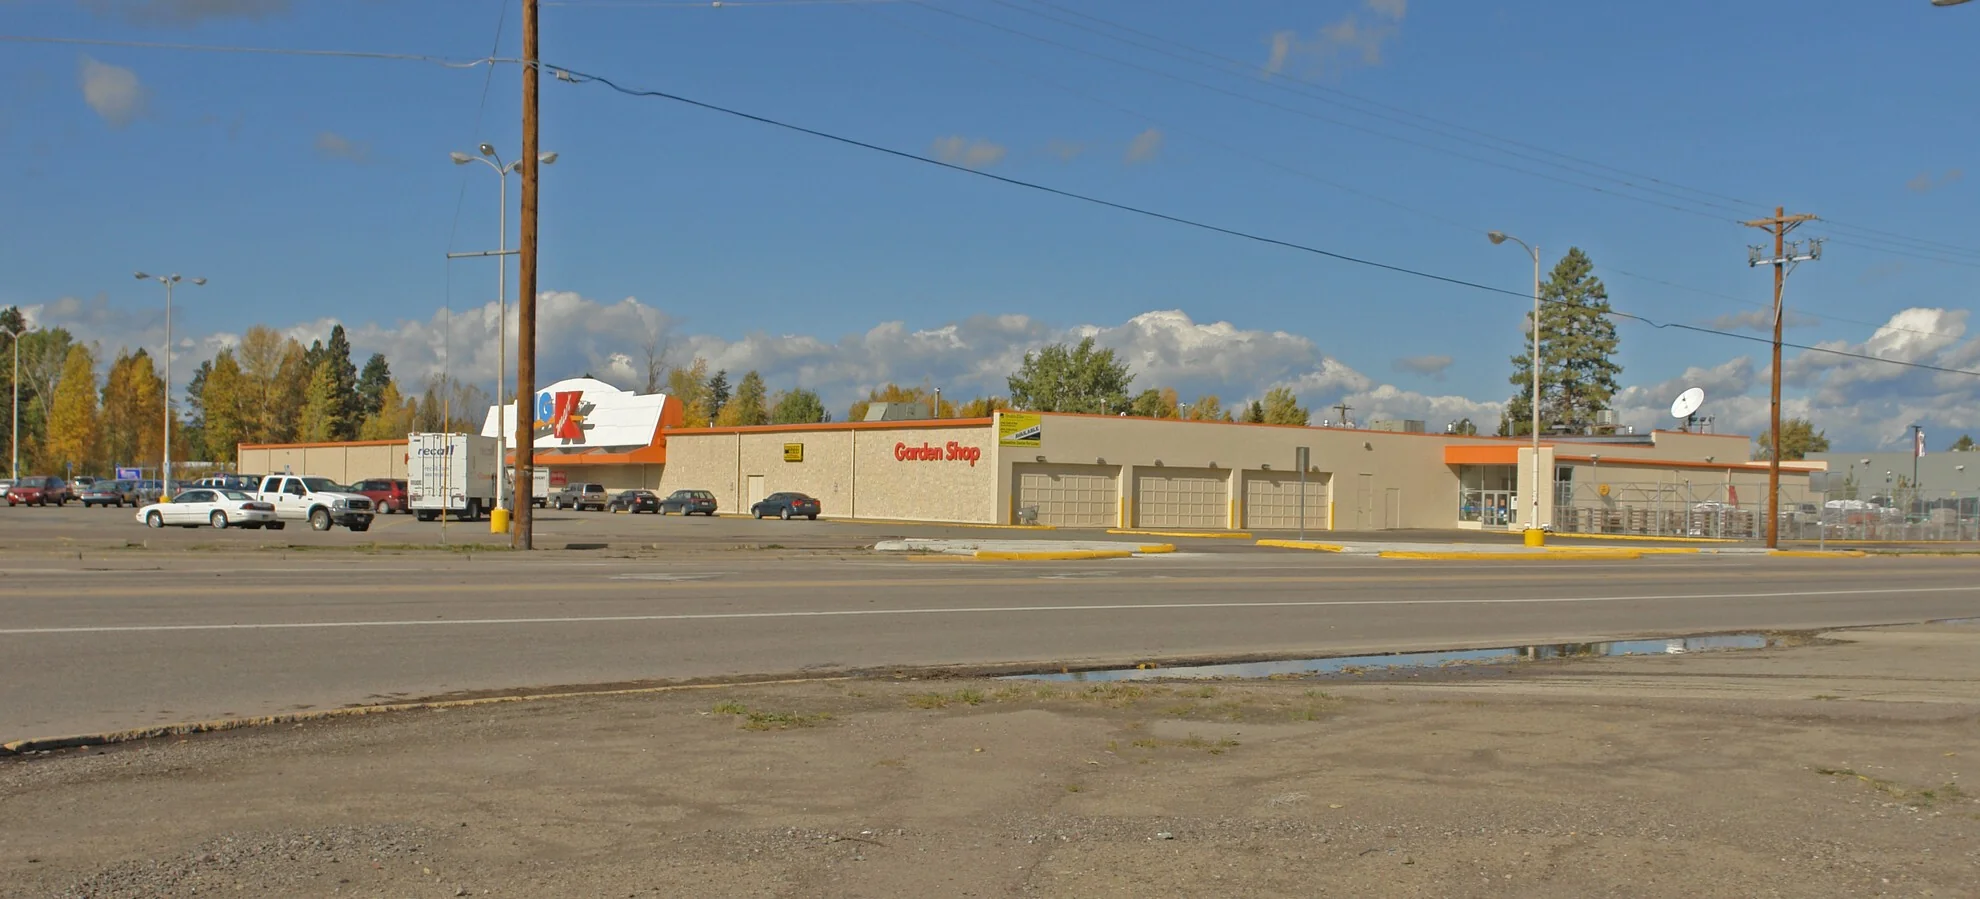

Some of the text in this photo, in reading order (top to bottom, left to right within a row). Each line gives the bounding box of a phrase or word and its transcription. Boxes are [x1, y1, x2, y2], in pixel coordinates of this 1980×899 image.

[417, 444, 454, 455] recall
[895, 441, 980, 467] Garden Shop
